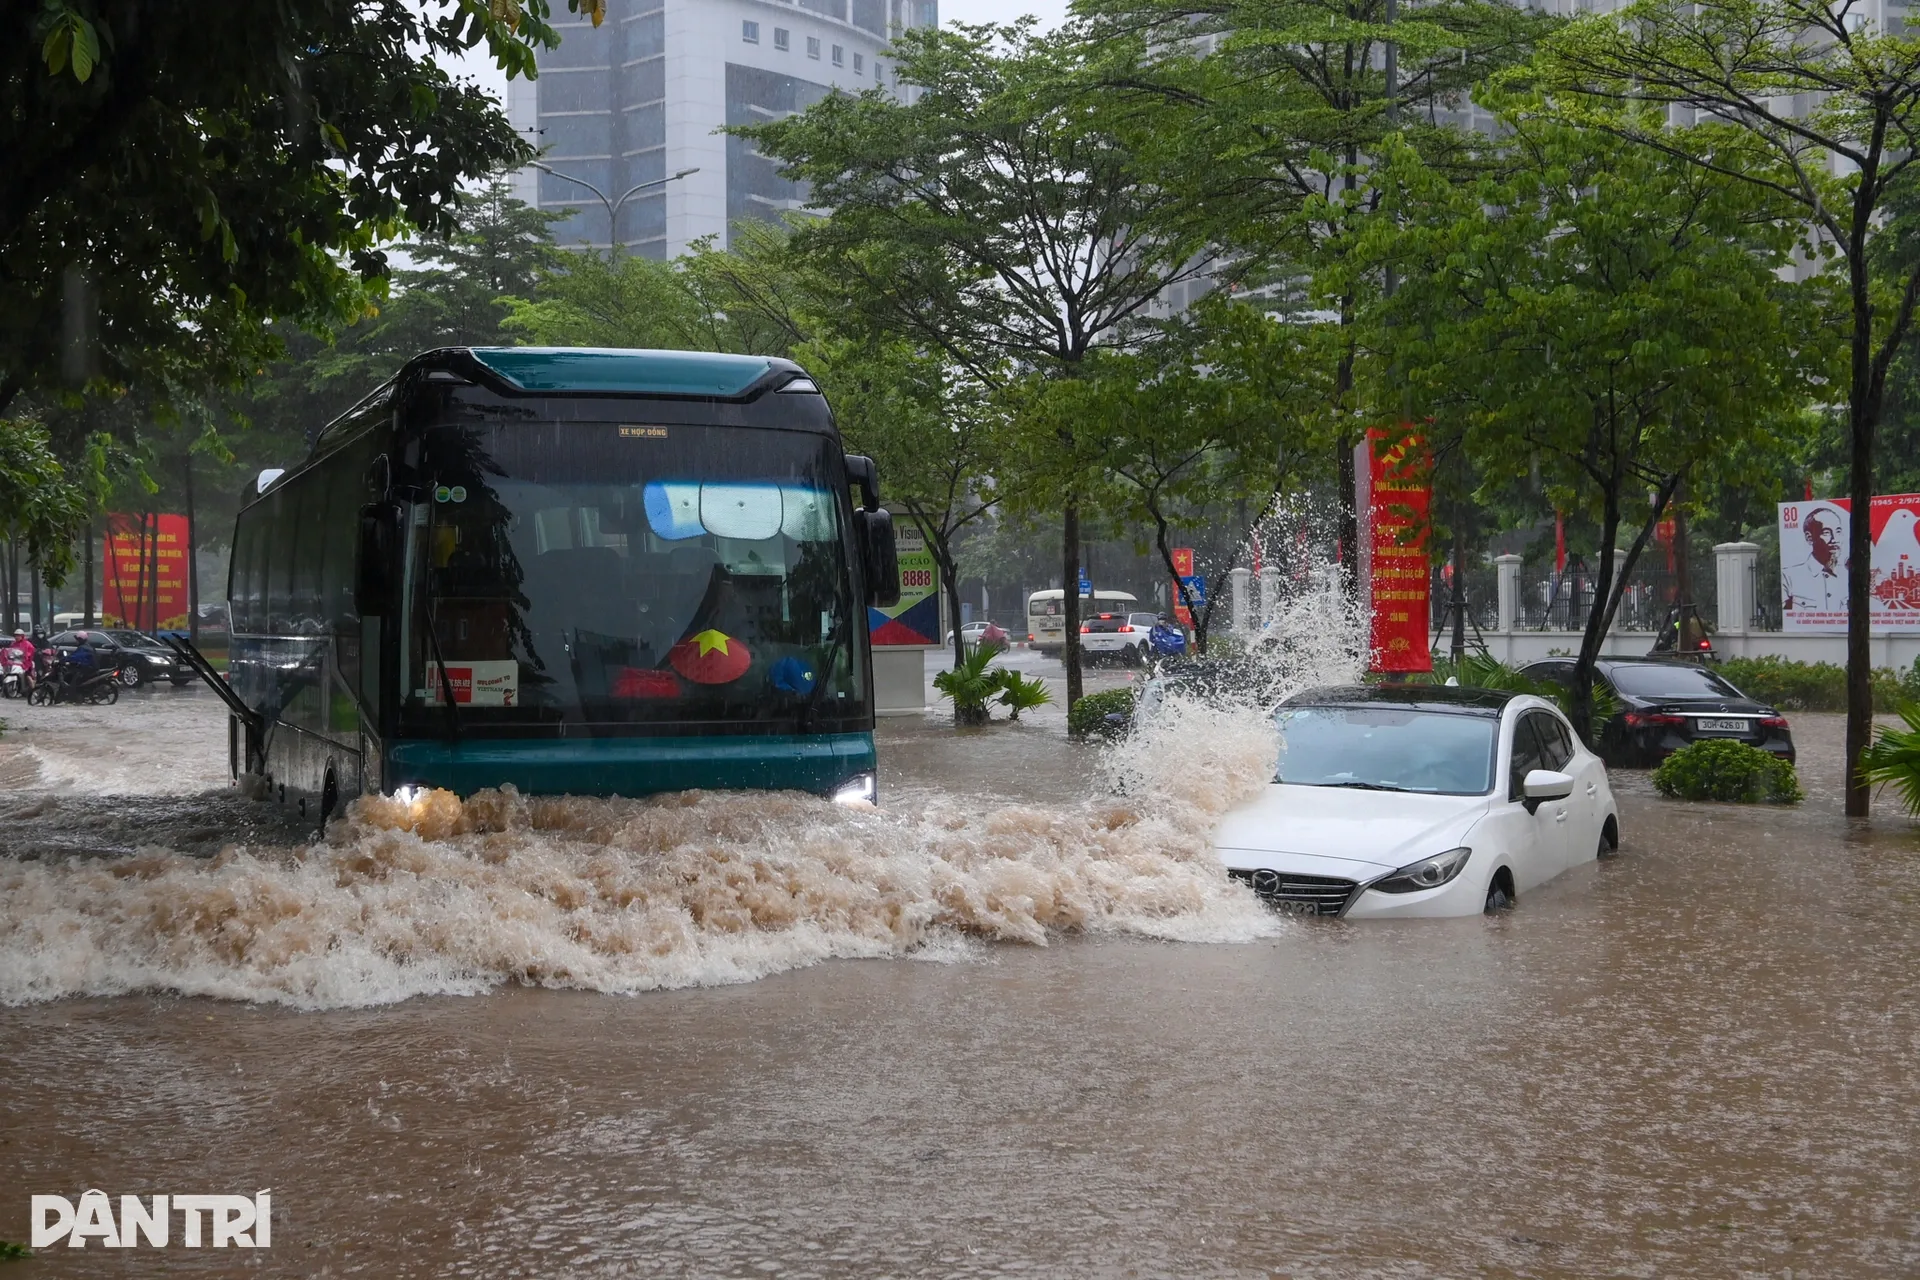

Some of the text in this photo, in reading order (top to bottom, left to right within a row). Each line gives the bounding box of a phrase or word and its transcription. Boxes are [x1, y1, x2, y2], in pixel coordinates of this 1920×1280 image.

[1784, 506, 1798, 521] 80
[902, 570, 931, 587] 8888
[1702, 720, 1745, 730] 30H-426.07
